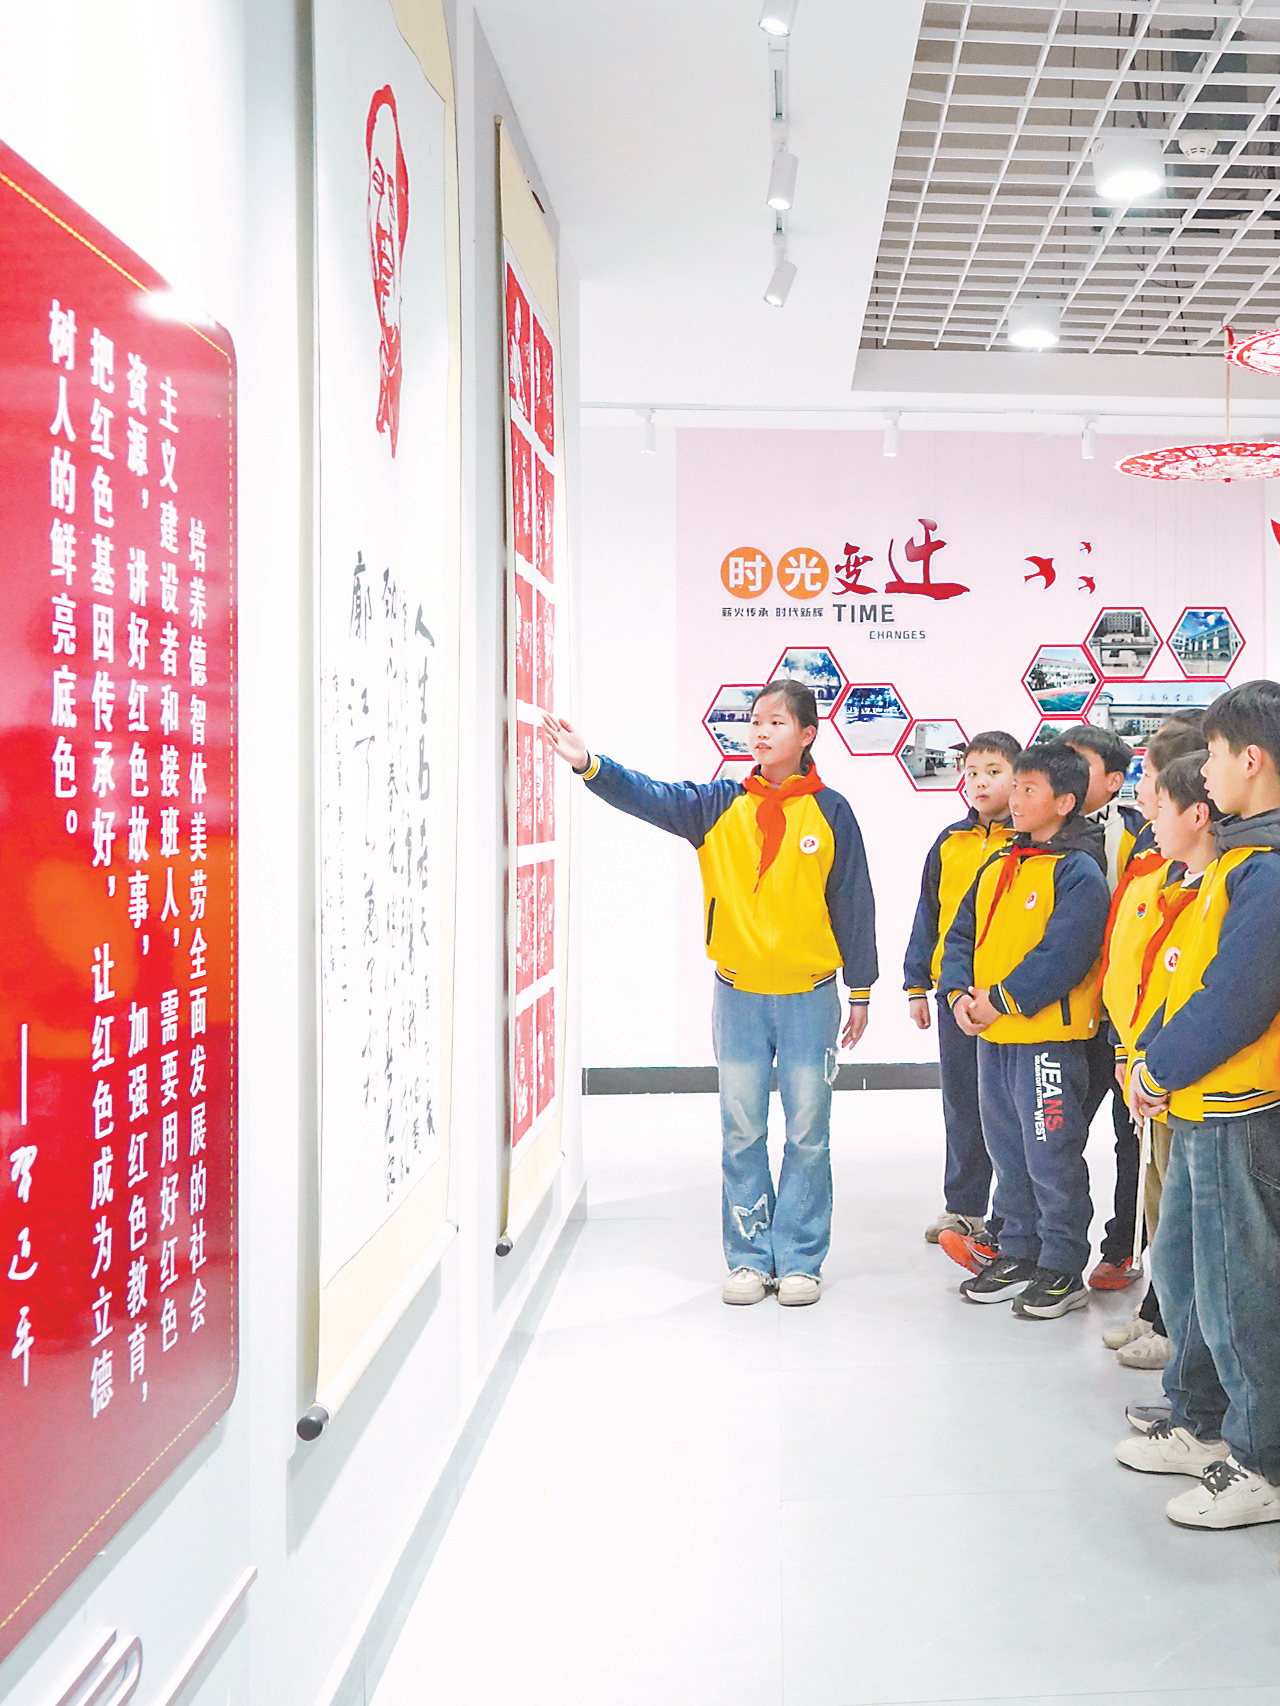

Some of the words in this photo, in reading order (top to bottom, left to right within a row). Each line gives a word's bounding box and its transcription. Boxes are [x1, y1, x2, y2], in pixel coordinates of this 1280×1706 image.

[50, 300, 78, 834] 树人的鲜亮底色。
[728, 518, 971, 600] 时光变迁
[721, 607, 769, 617] 薪火传承
[775, 606, 824, 618] 时代新辉
[832, 603, 895, 623] TIME
[869, 630, 926, 640] CHANGES
[188, 517, 207, 1334] 培养德智体美劳全面发展的社会
[1041, 1052, 1064, 1131] JEANS
[1034, 1109, 1047, 1142] WEST
